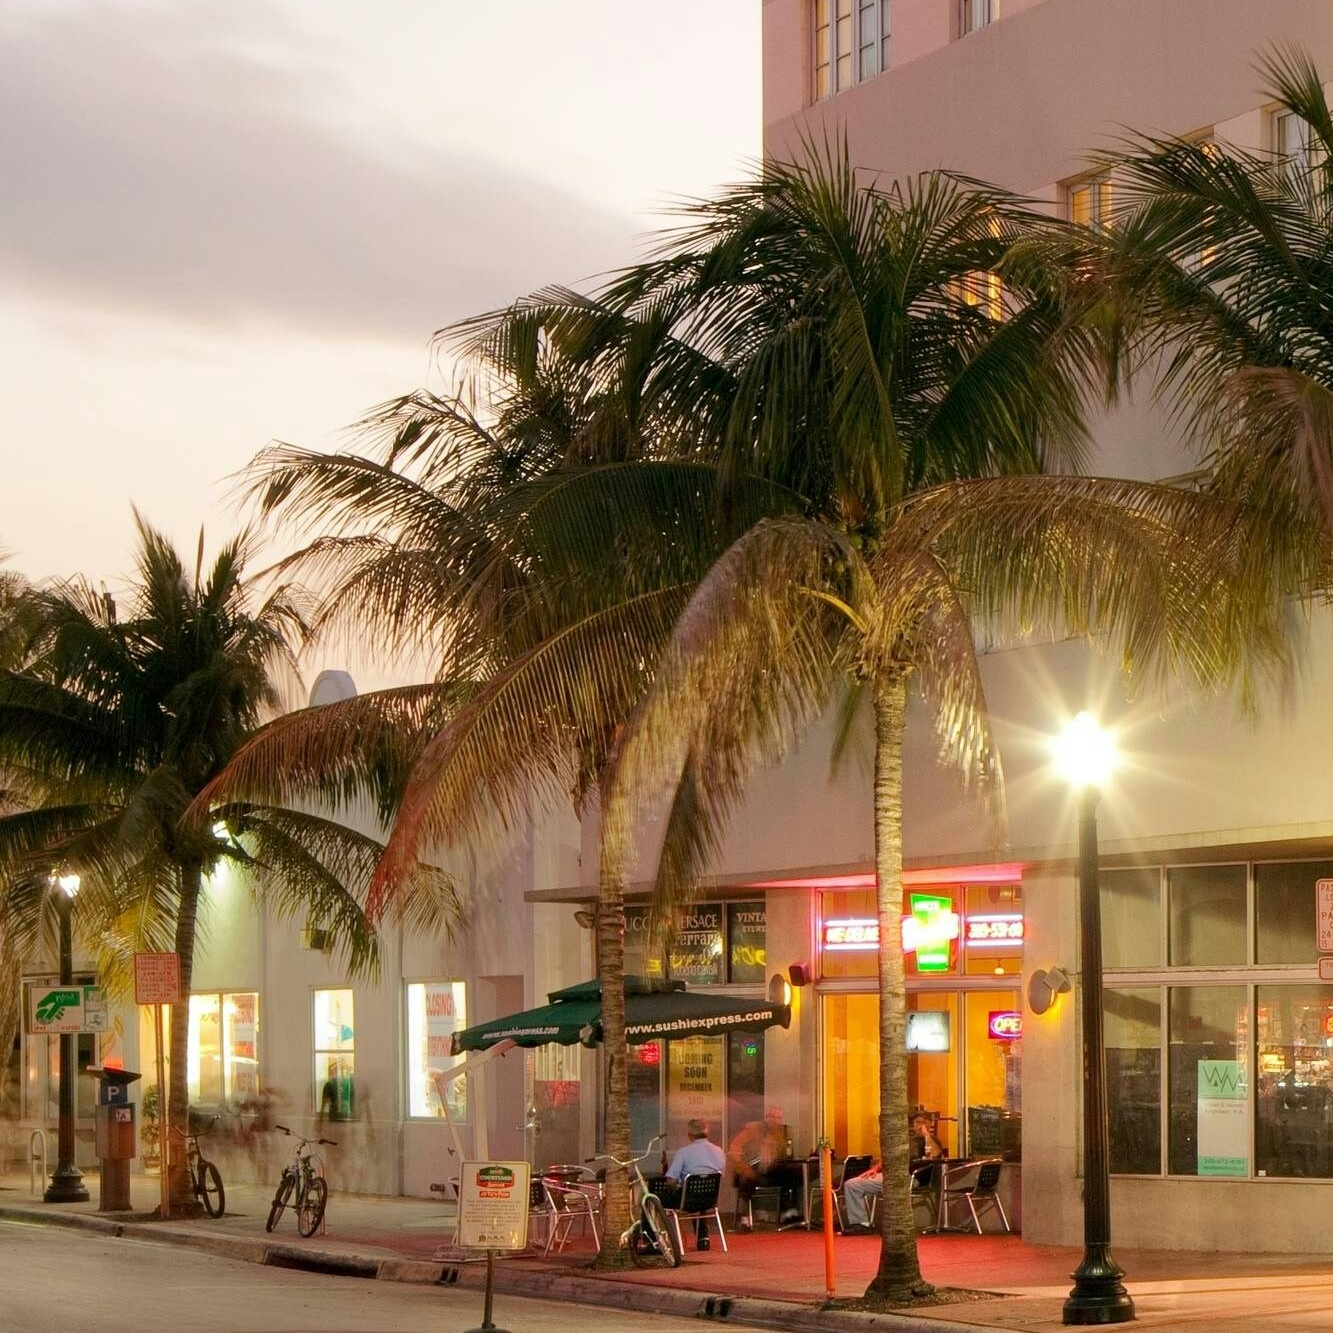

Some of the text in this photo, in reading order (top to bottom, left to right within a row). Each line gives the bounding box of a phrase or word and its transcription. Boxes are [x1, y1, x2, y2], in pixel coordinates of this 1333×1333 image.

[679, 913, 718, 929] ERSACE
[1321, 930, 1331, 939] 24
[684, 1067, 707, 1078] SOON
[679, 1083, 712, 1092] DECEMBER
[107, 1086, 120, 1102] P
